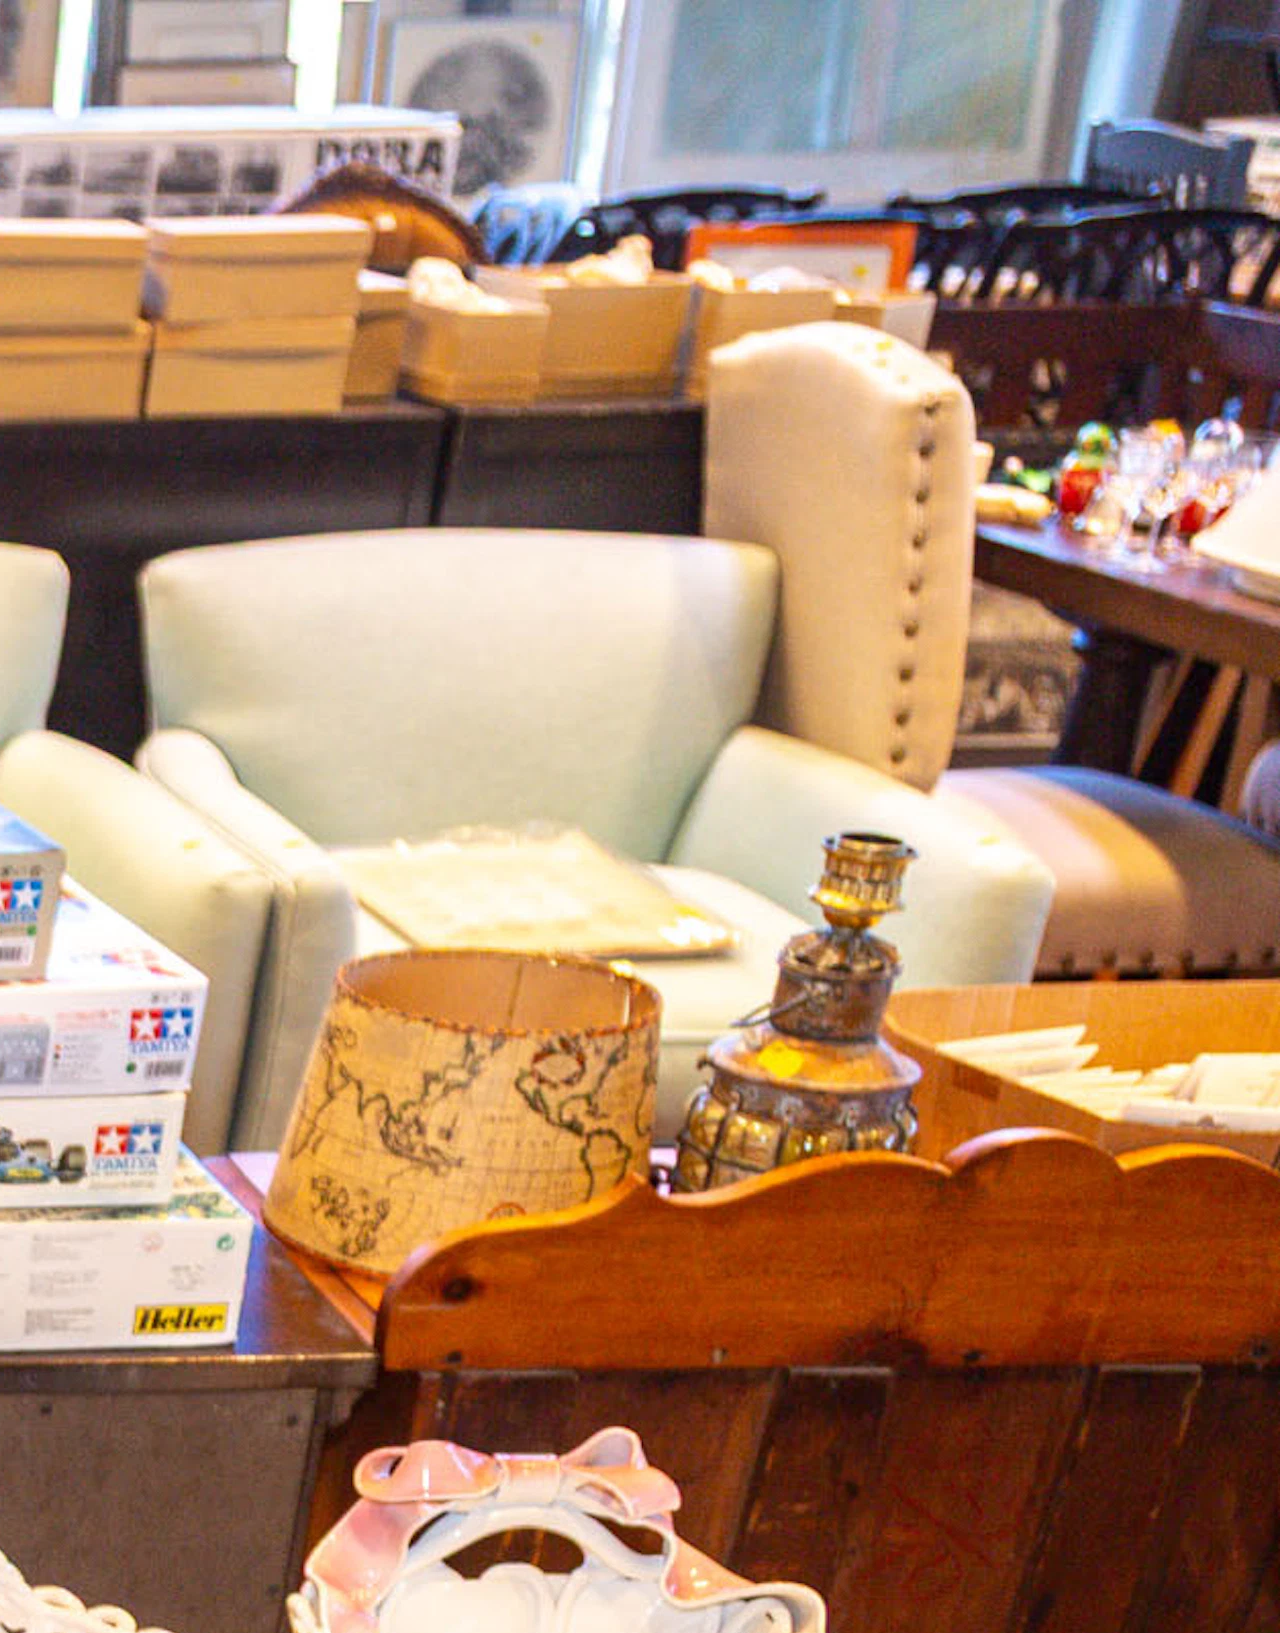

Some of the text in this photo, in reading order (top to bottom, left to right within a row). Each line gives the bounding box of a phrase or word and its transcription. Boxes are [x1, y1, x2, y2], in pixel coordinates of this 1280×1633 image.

[128, 1041, 191, 1054] TAMIYA
[94, 1157, 158, 1170] TAMIYA
[138, 1307, 224, 1329] Heller
